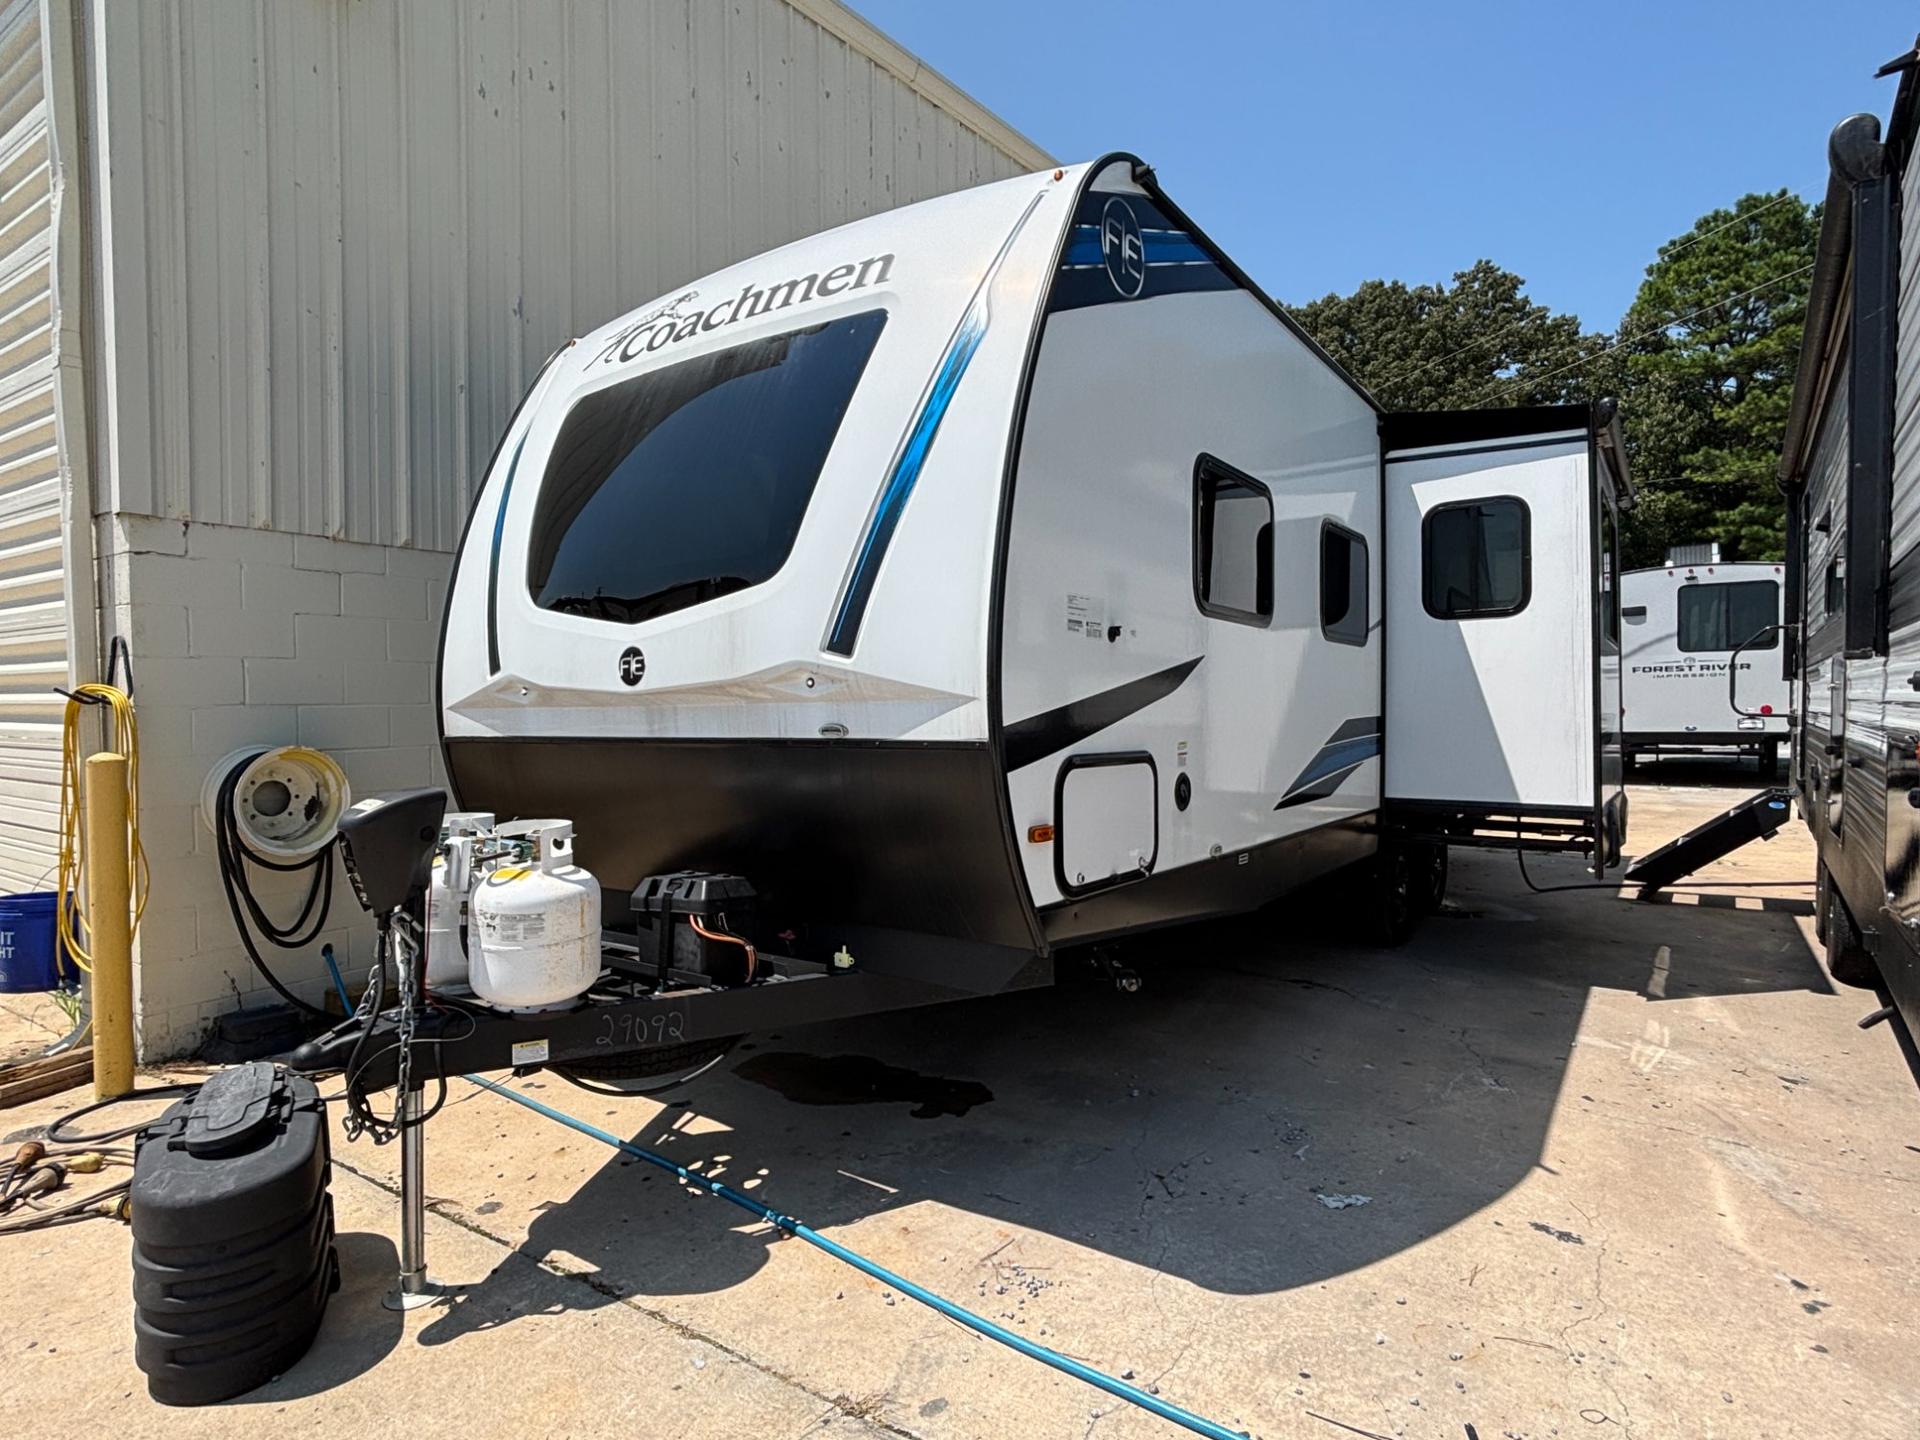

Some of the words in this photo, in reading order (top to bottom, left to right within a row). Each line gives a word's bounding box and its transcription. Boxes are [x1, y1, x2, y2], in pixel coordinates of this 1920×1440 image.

[618, 253, 896, 364] Coachmen
[1632, 664, 1696, 674] FOREST
[595, 1010, 686, 1046] 29092
